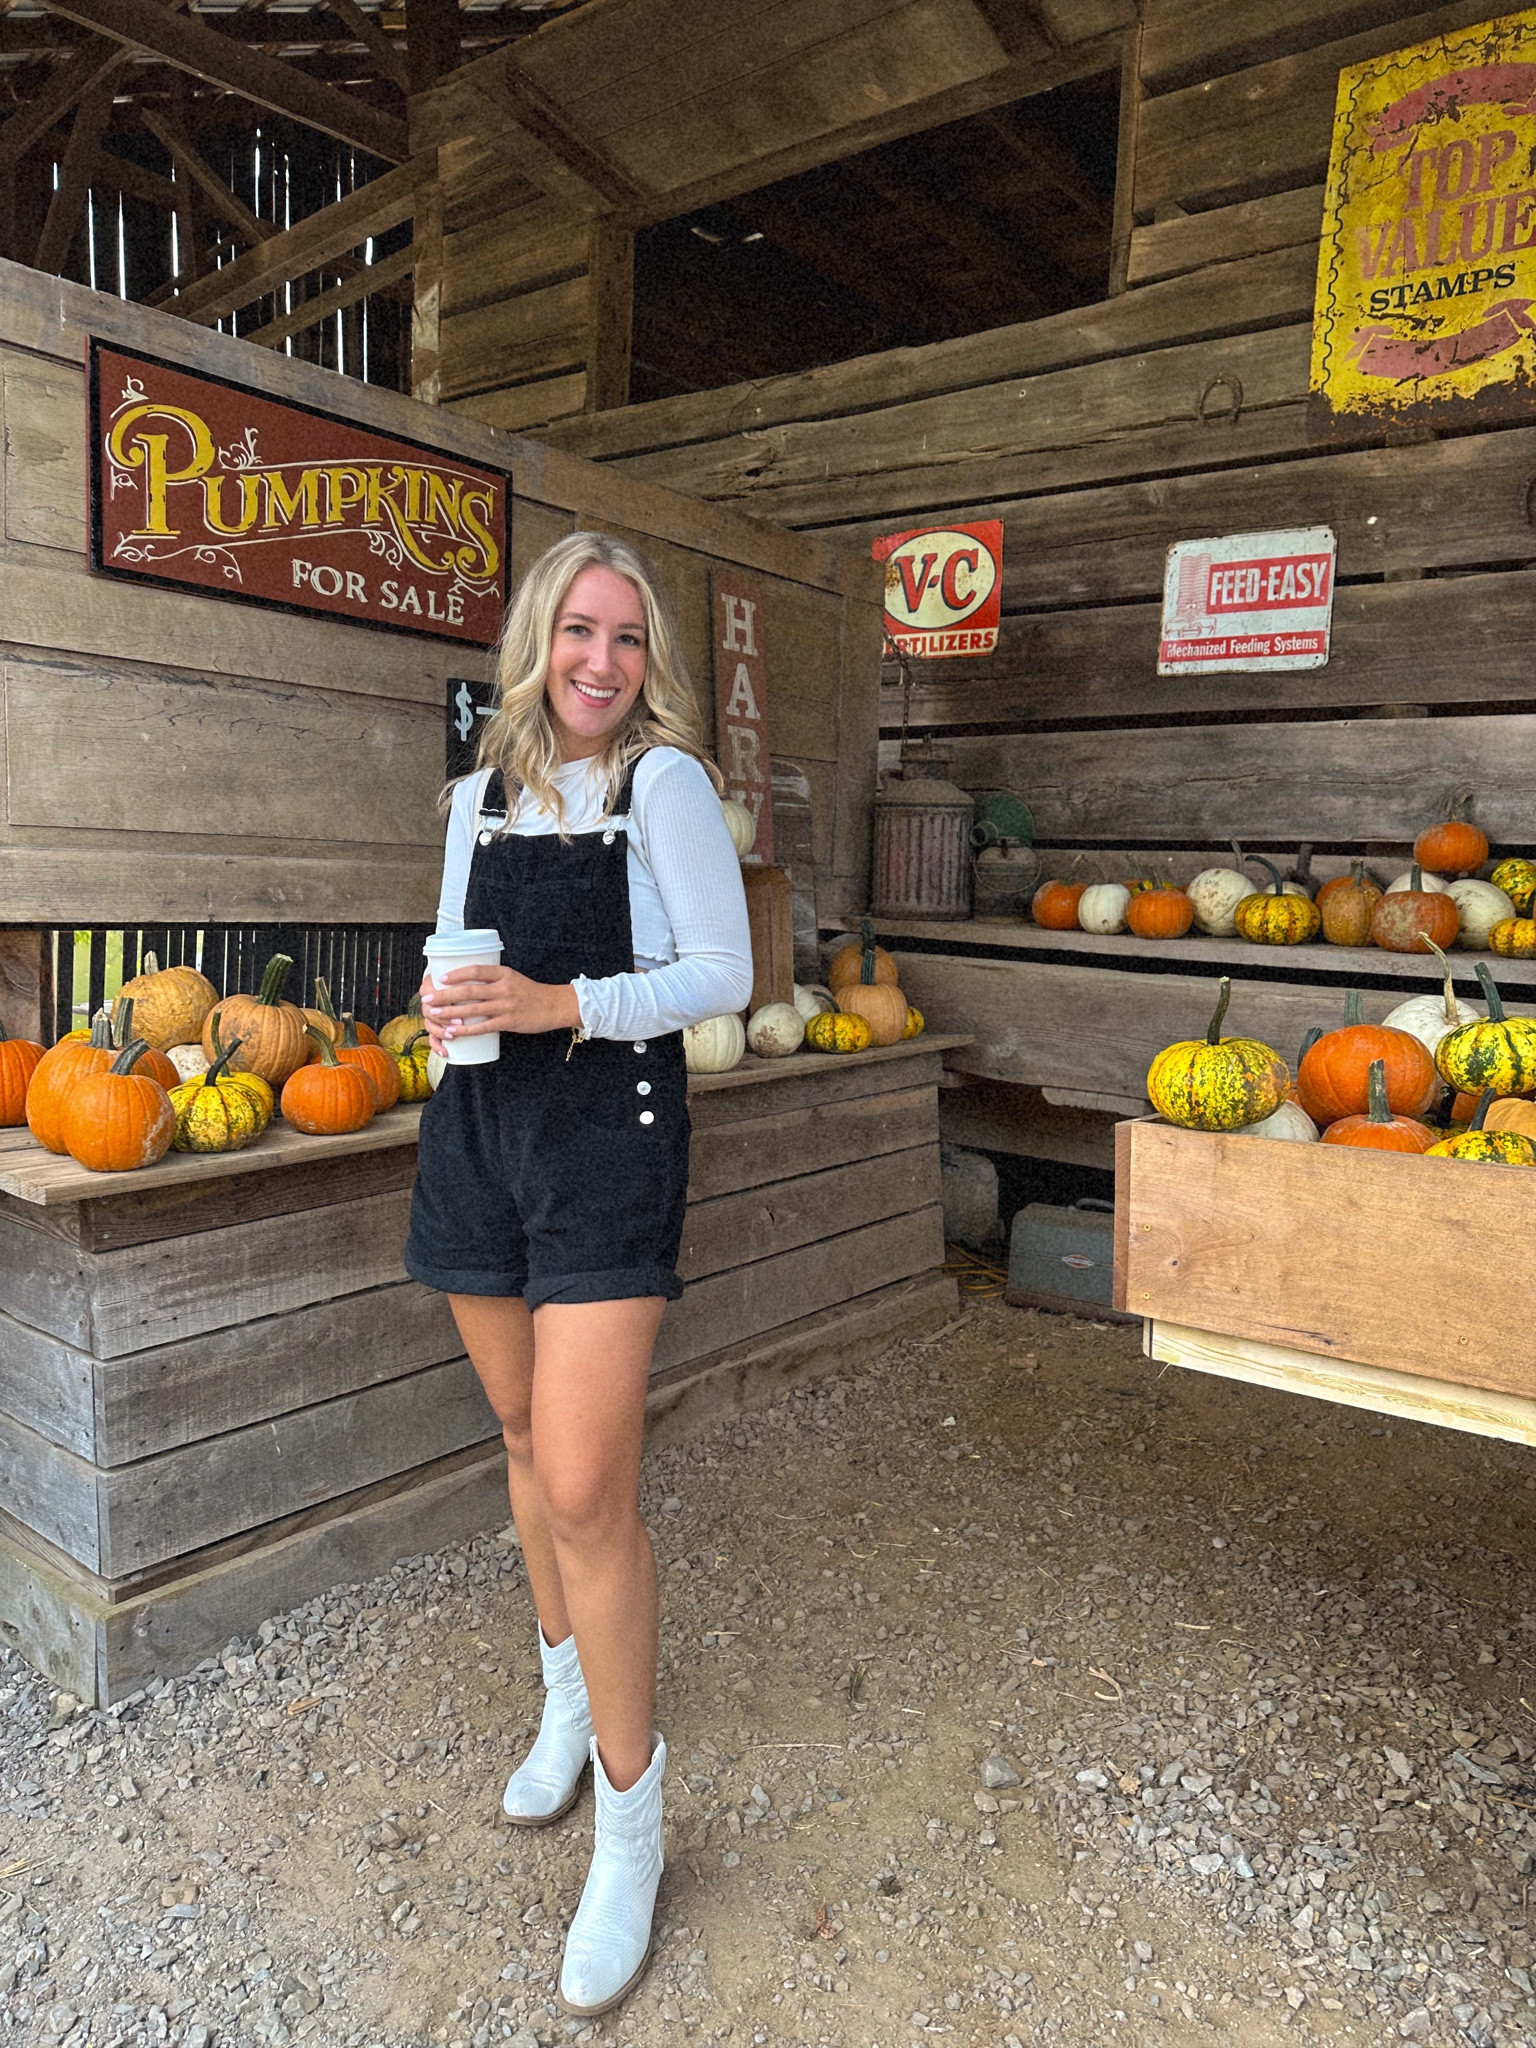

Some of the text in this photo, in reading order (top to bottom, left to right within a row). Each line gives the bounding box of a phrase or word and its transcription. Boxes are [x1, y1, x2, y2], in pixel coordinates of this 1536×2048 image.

[1398, 129, 1516, 209] TOP
[1355, 188, 1536, 281] VALUE
[1369, 262, 1516, 313] STAMPS
[107, 404, 500, 578] PUMPKINS
[291, 558, 466, 626] FOR SALE
[894, 548, 979, 614] V-C
[1209, 561, 1328, 606] FEED-EASY
[1167, 636, 1318, 657] Mechanized Feeding Systems
[721, 592, 766, 864] HARV
